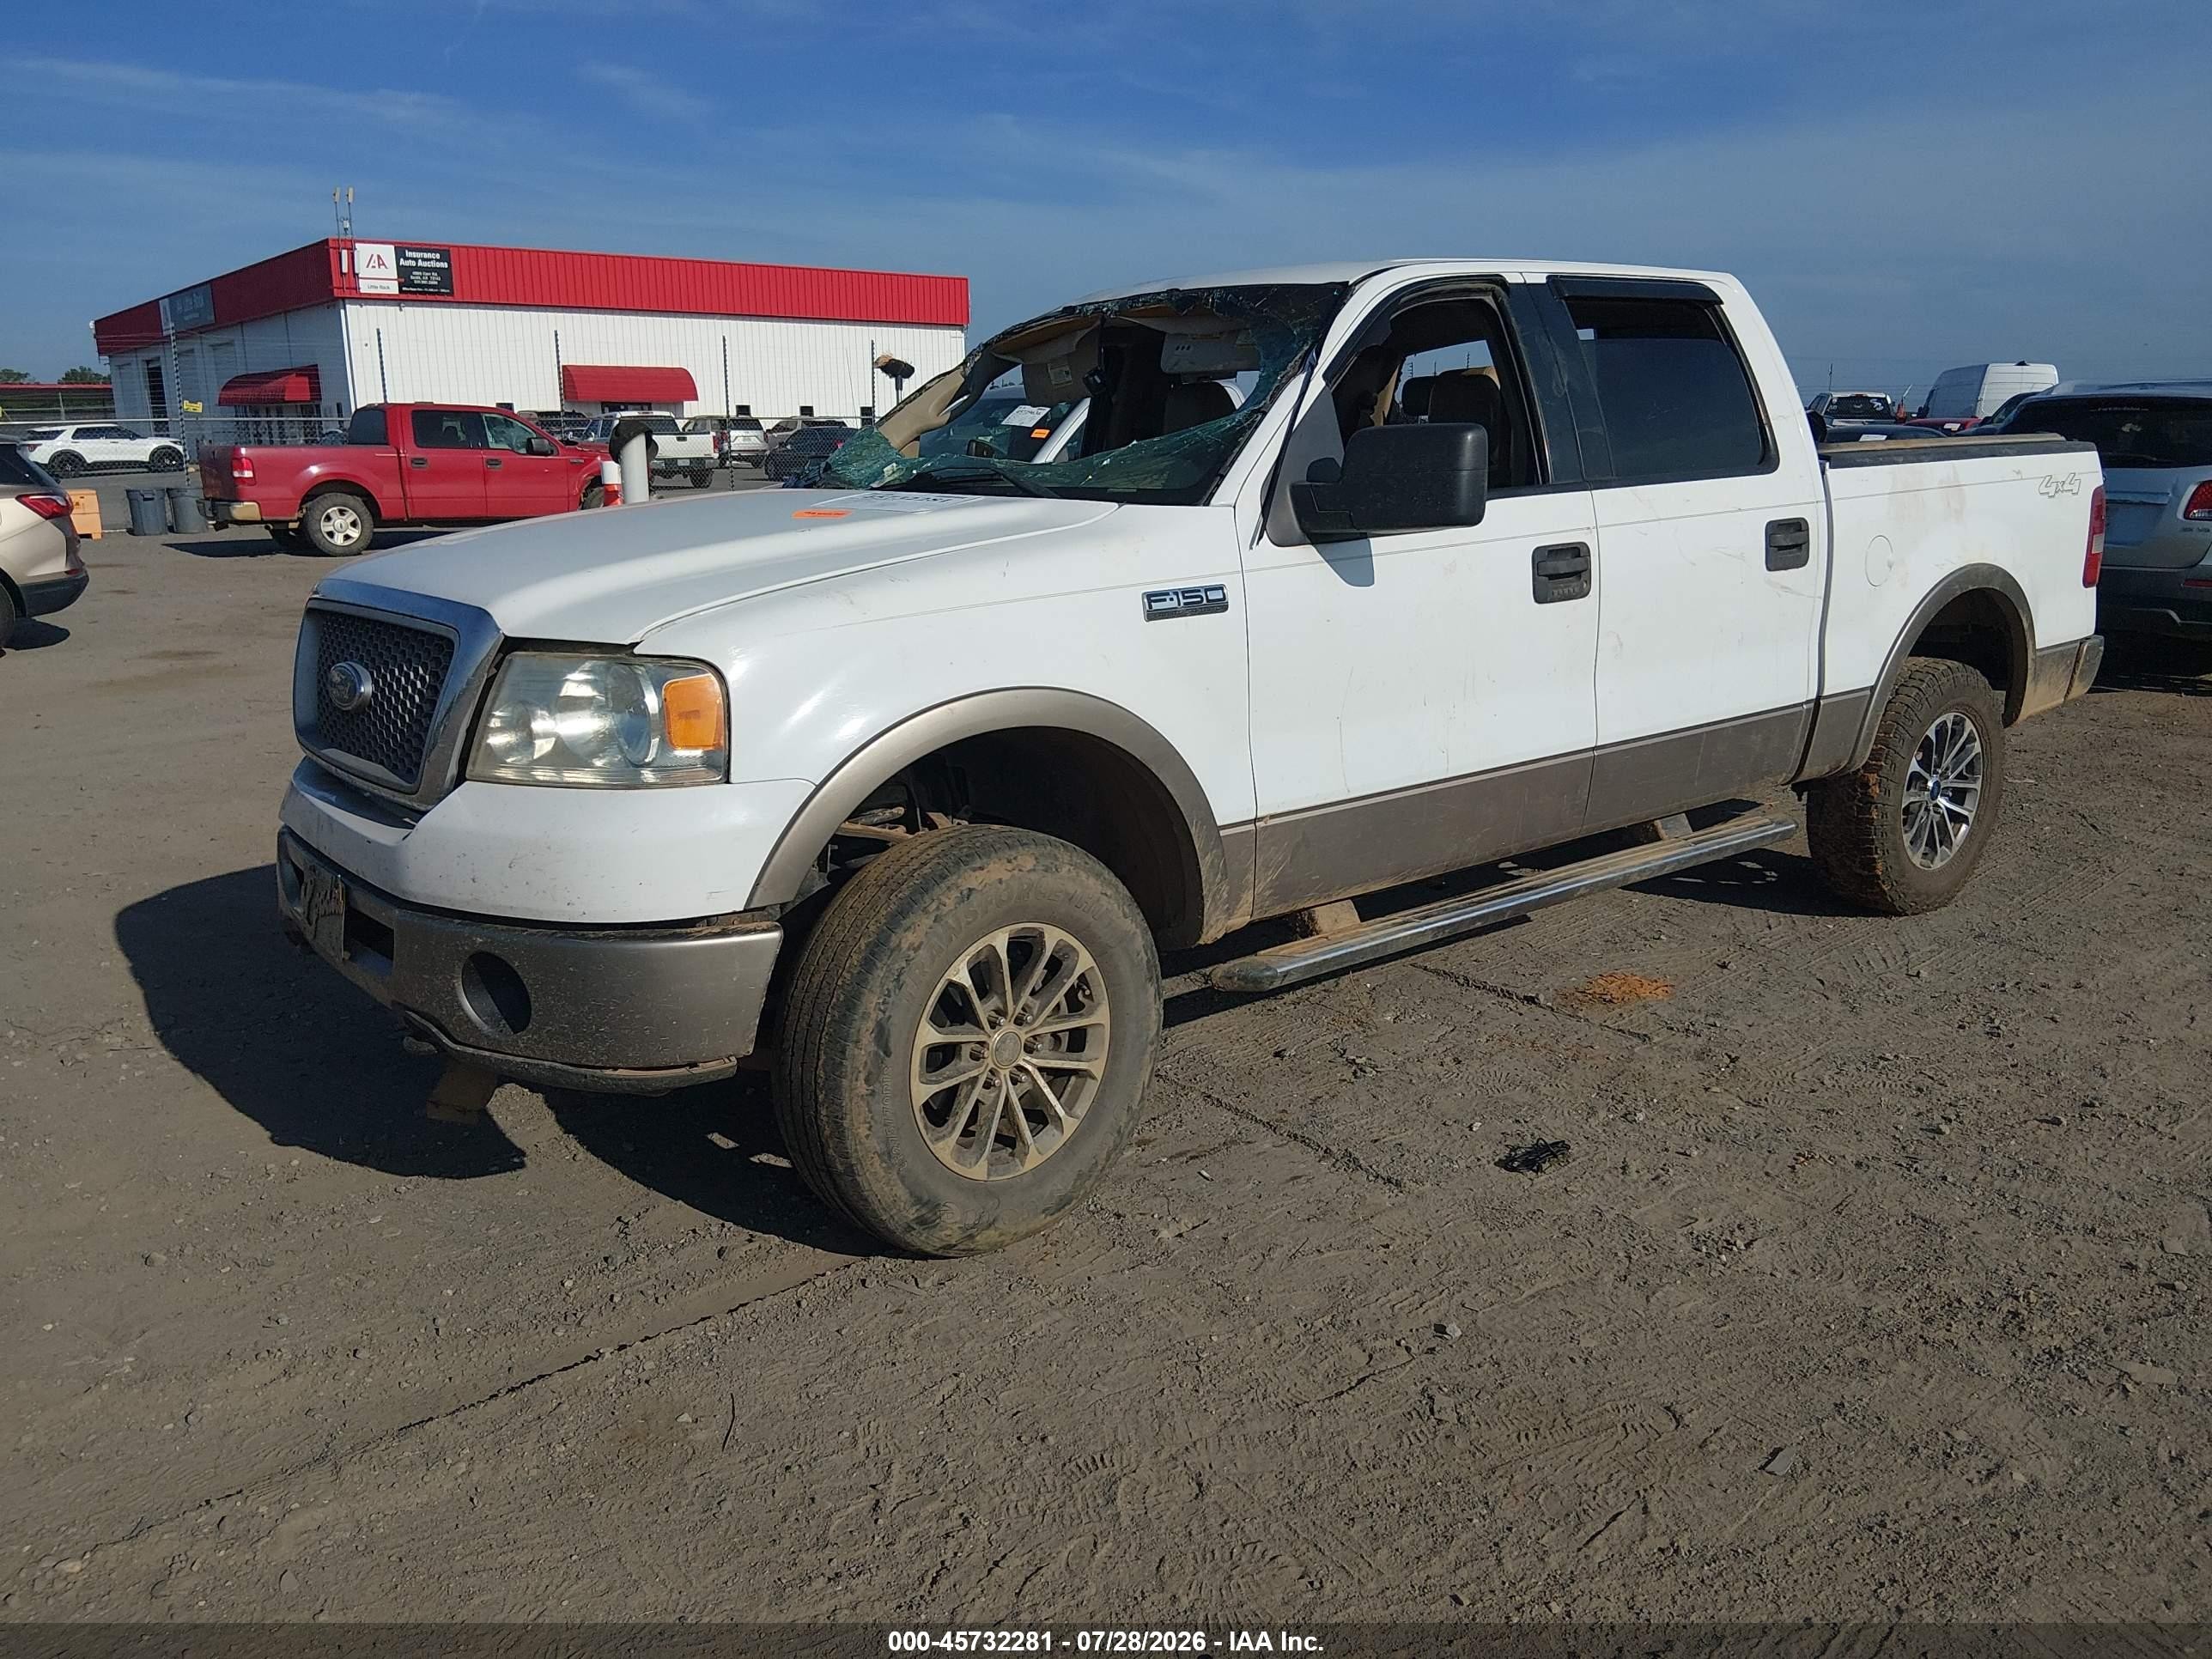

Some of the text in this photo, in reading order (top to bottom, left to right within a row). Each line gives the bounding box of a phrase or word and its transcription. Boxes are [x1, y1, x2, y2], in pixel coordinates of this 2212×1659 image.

[399, 258, 448, 269] Auto Auctions
[404, 250, 441, 259] Insurance
[2039, 472, 2081, 498] 4x4
[1146, 586, 1227, 611] F-150
